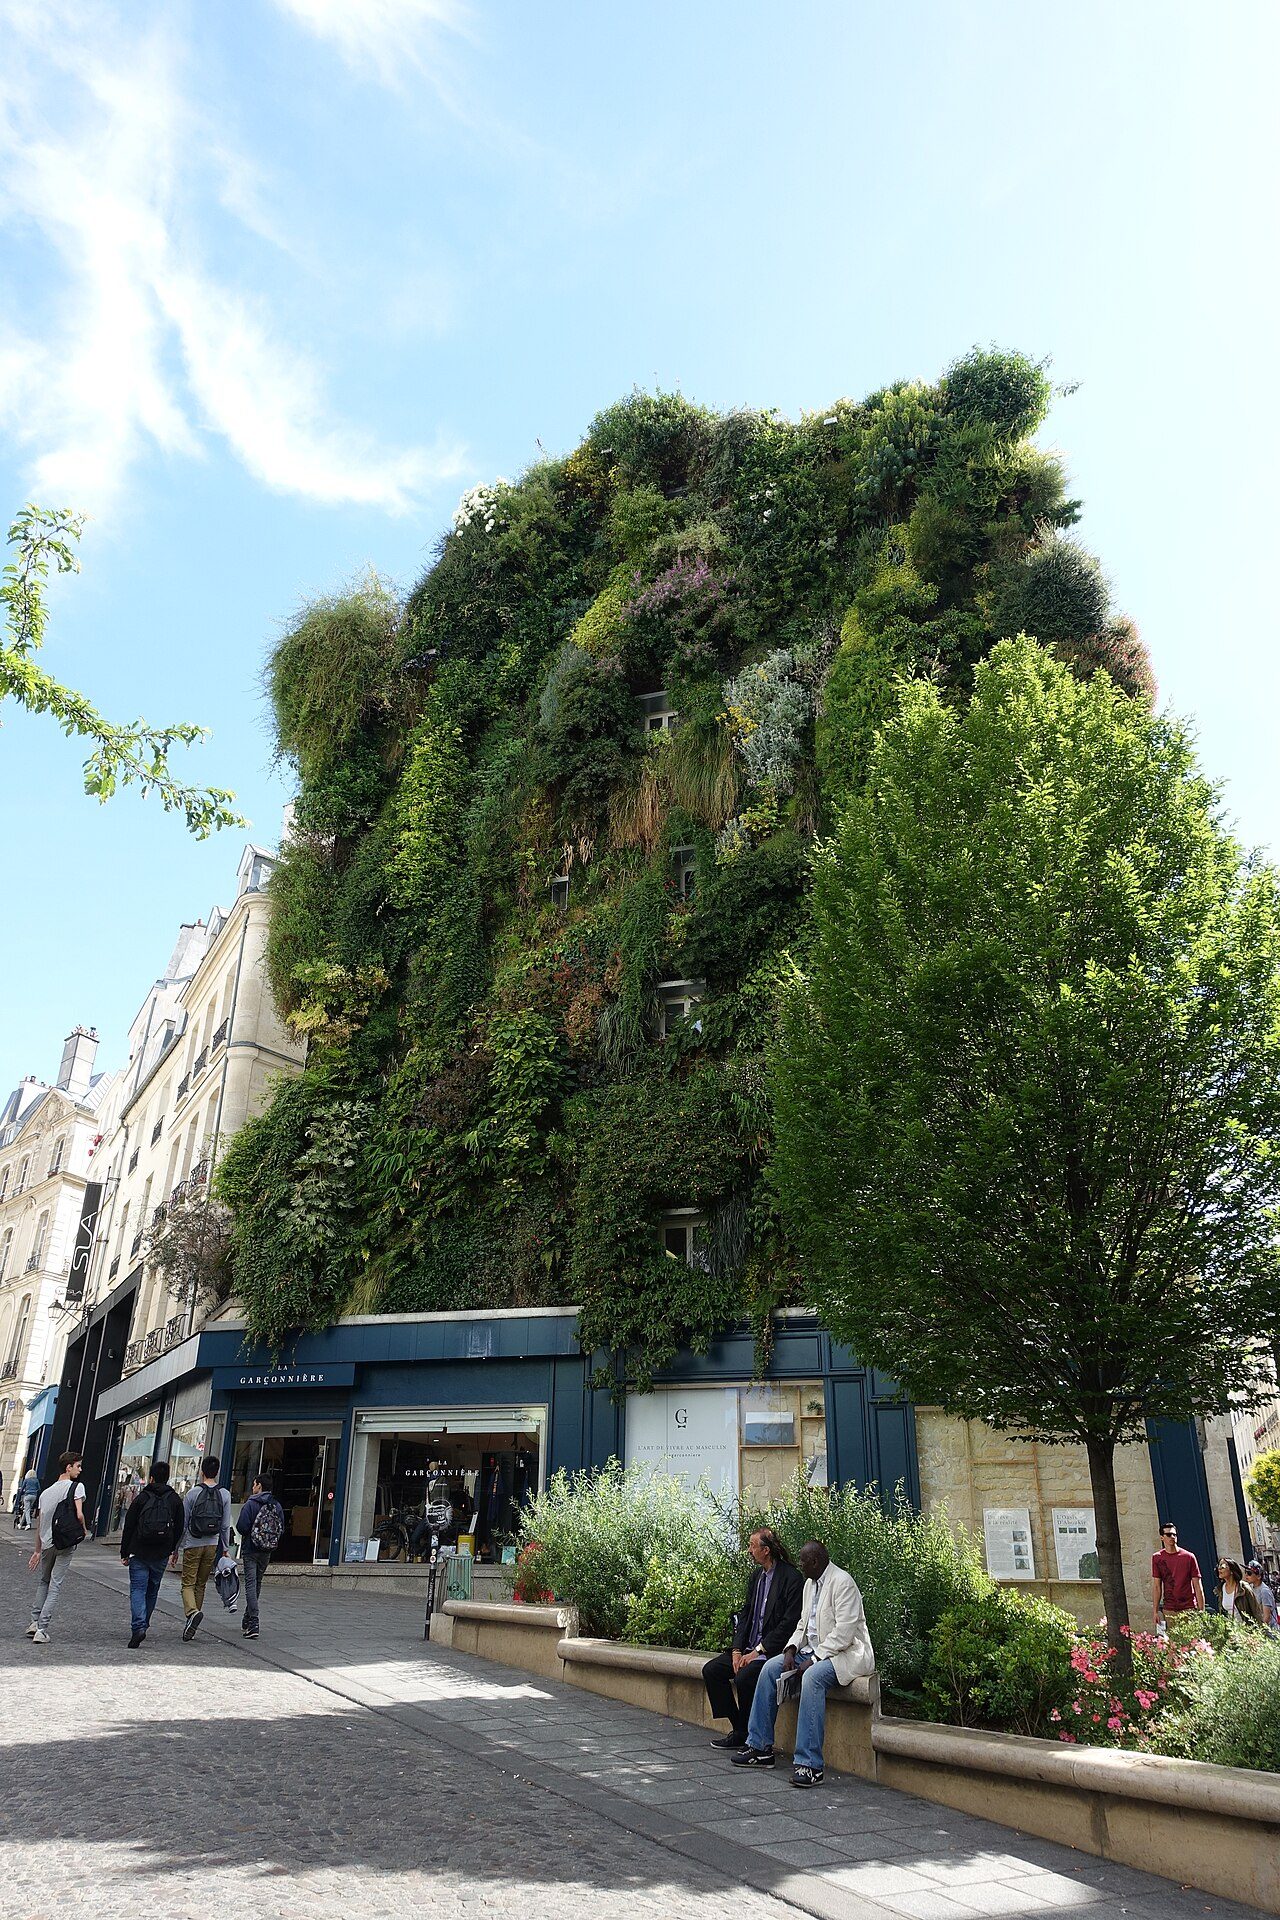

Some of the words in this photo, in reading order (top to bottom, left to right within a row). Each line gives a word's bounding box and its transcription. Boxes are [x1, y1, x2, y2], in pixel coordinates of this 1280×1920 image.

[240, 1373, 324, 1385] GARÇONNIÈRE
[675, 1408, 688, 1424] G
[405, 1468, 480, 1478] GARÇONNIÈRE
